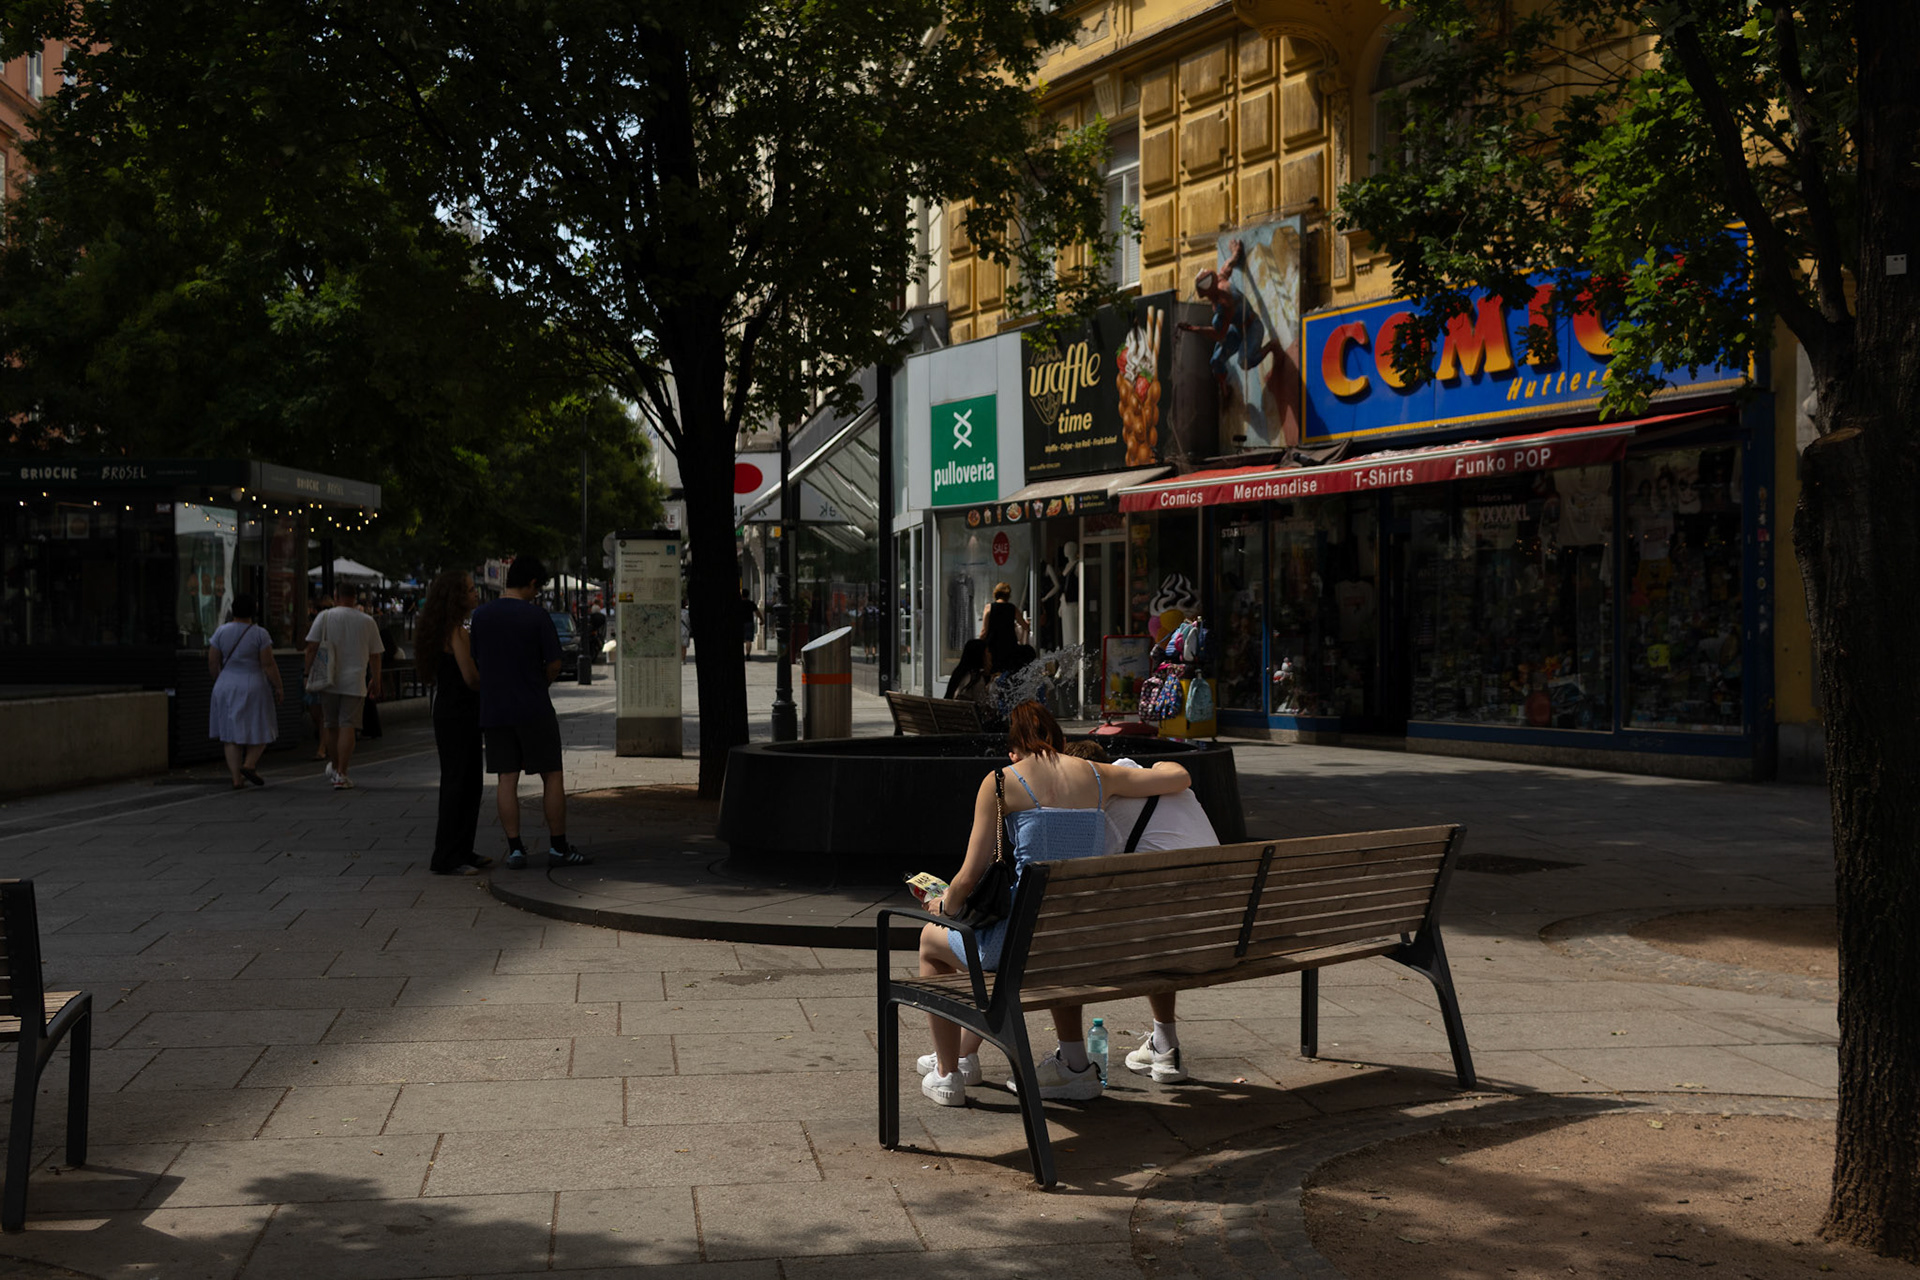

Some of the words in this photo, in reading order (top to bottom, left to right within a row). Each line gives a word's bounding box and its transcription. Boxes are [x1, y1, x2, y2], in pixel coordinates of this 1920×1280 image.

[1058, 408, 1093, 434] time
[1455, 456, 1505, 475] Funko
[1514, 447, 1552, 469] POP
[20, 466, 78, 480] BRIOCHE
[934, 456, 995, 492] pulloveria
[1354, 467, 1414, 488] T-Shirts
[1161, 490, 1203, 507] Comics
[1233, 478, 1317, 500] Merchandise
[994, 543, 1008, 554] SALE
